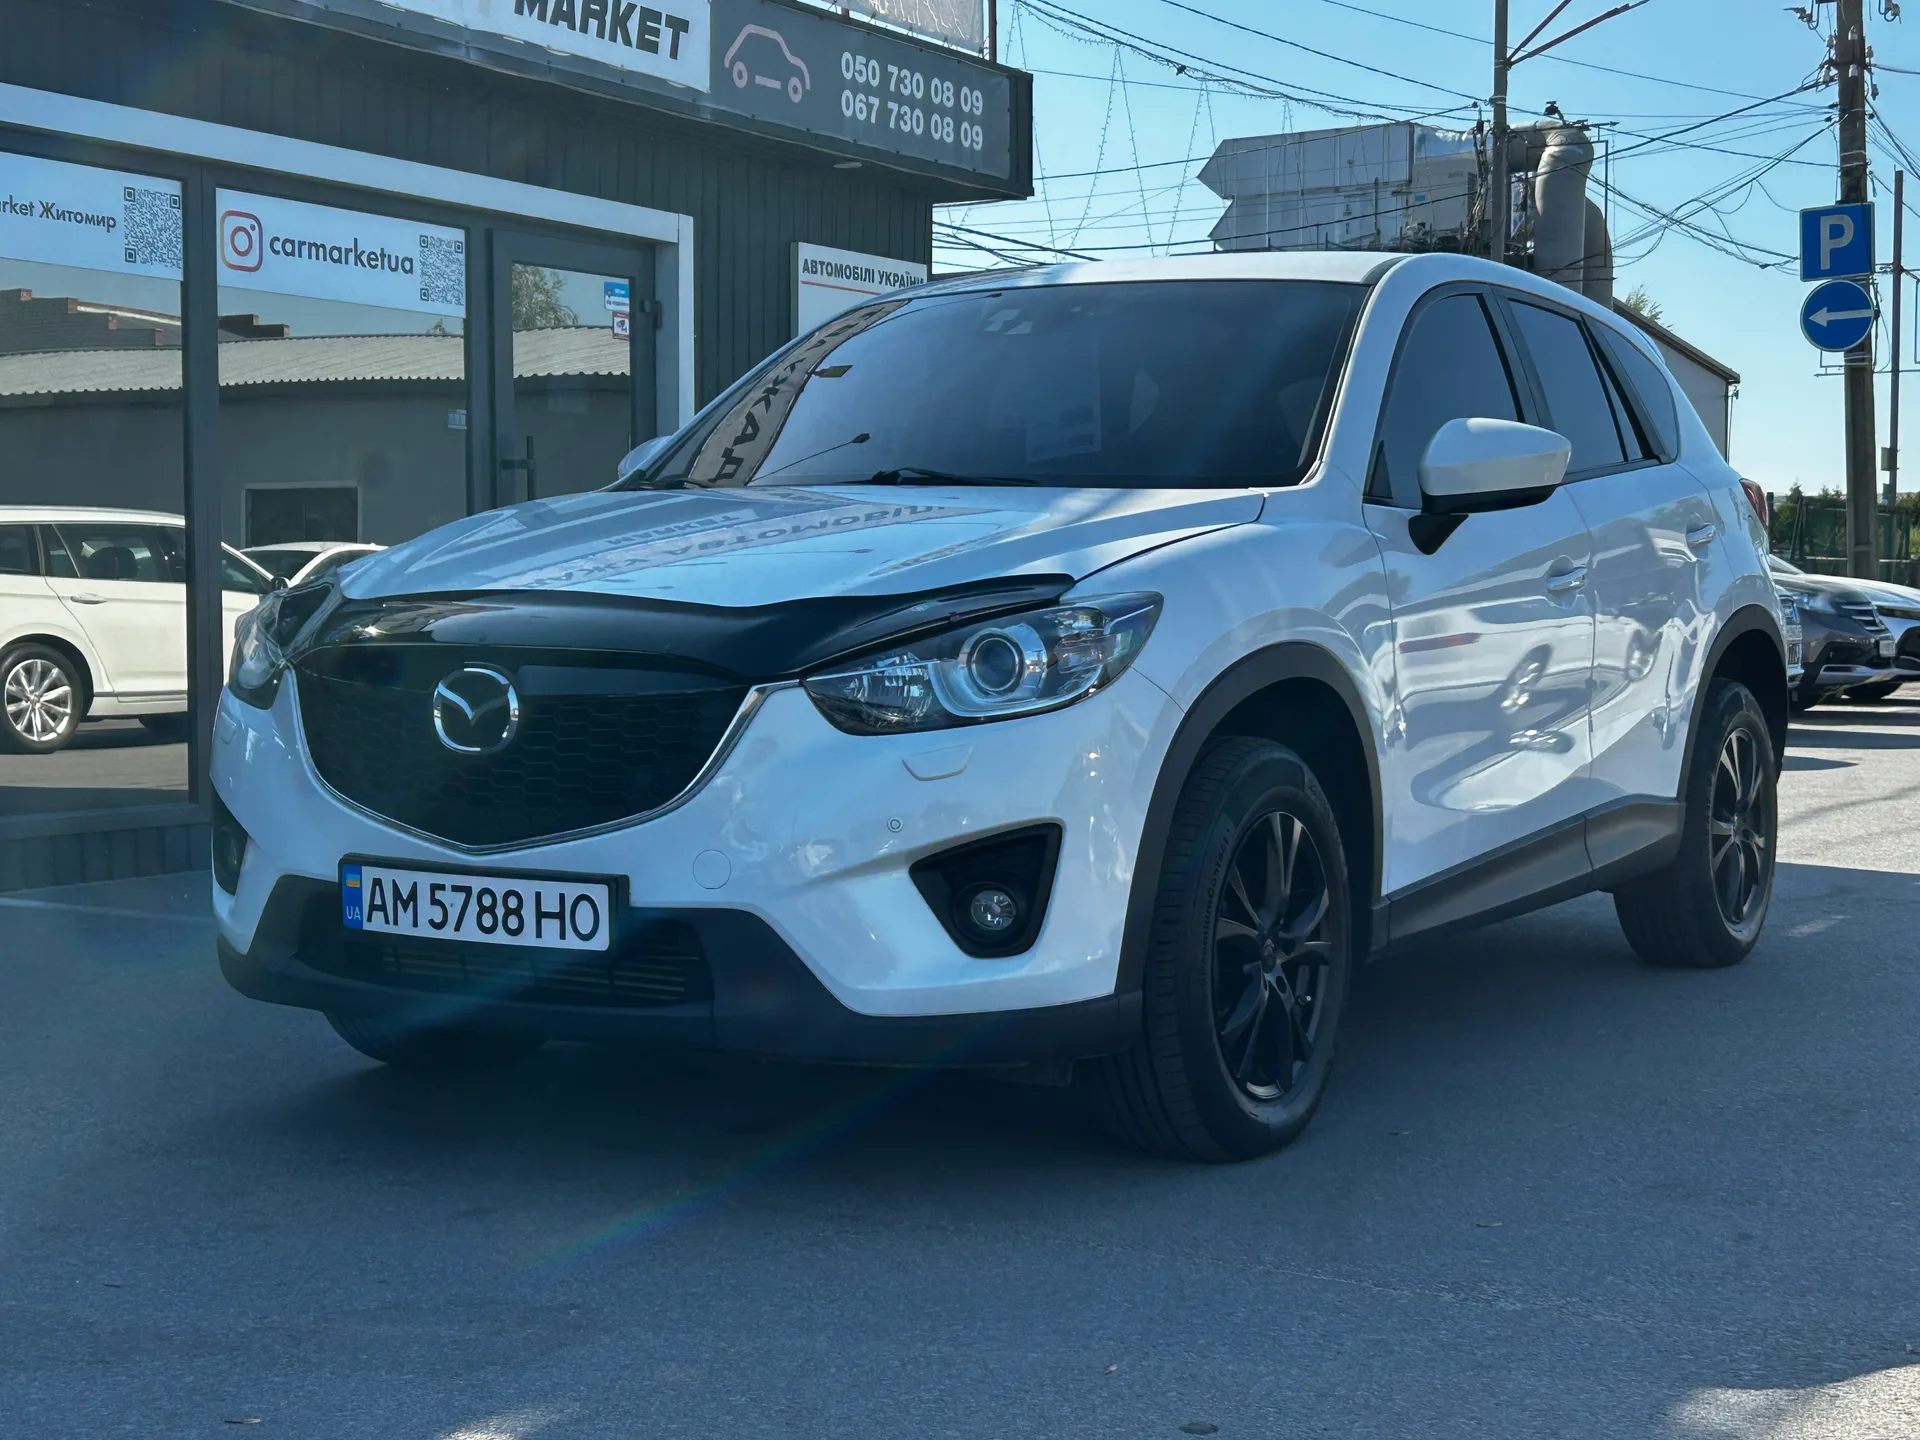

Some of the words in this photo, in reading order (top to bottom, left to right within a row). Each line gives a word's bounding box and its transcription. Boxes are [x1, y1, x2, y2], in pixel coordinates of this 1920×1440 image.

[841, 51, 880, 87] 050
[887, 64, 924, 99] 730
[930, 77, 954, 108] 08
[960, 86, 983, 116] 09
[841, 89, 880, 124] 067
[887, 101, 924, 135] 730
[930, 113, 954, 143] 08
[960, 121, 983, 150] 09
[0, 194, 35, 217] rket
[38, 199, 117, 233] Житомир
[269, 234, 414, 275] carmarketua
[1820, 214, 1854, 270] P
[802, 258, 875, 283] АВТОМОБІЛІ
[346, 906, 361, 921] UA
[366, 877, 418, 928] AM
[427, 883, 525, 937] 5788
[535, 891, 600, 942] HO
